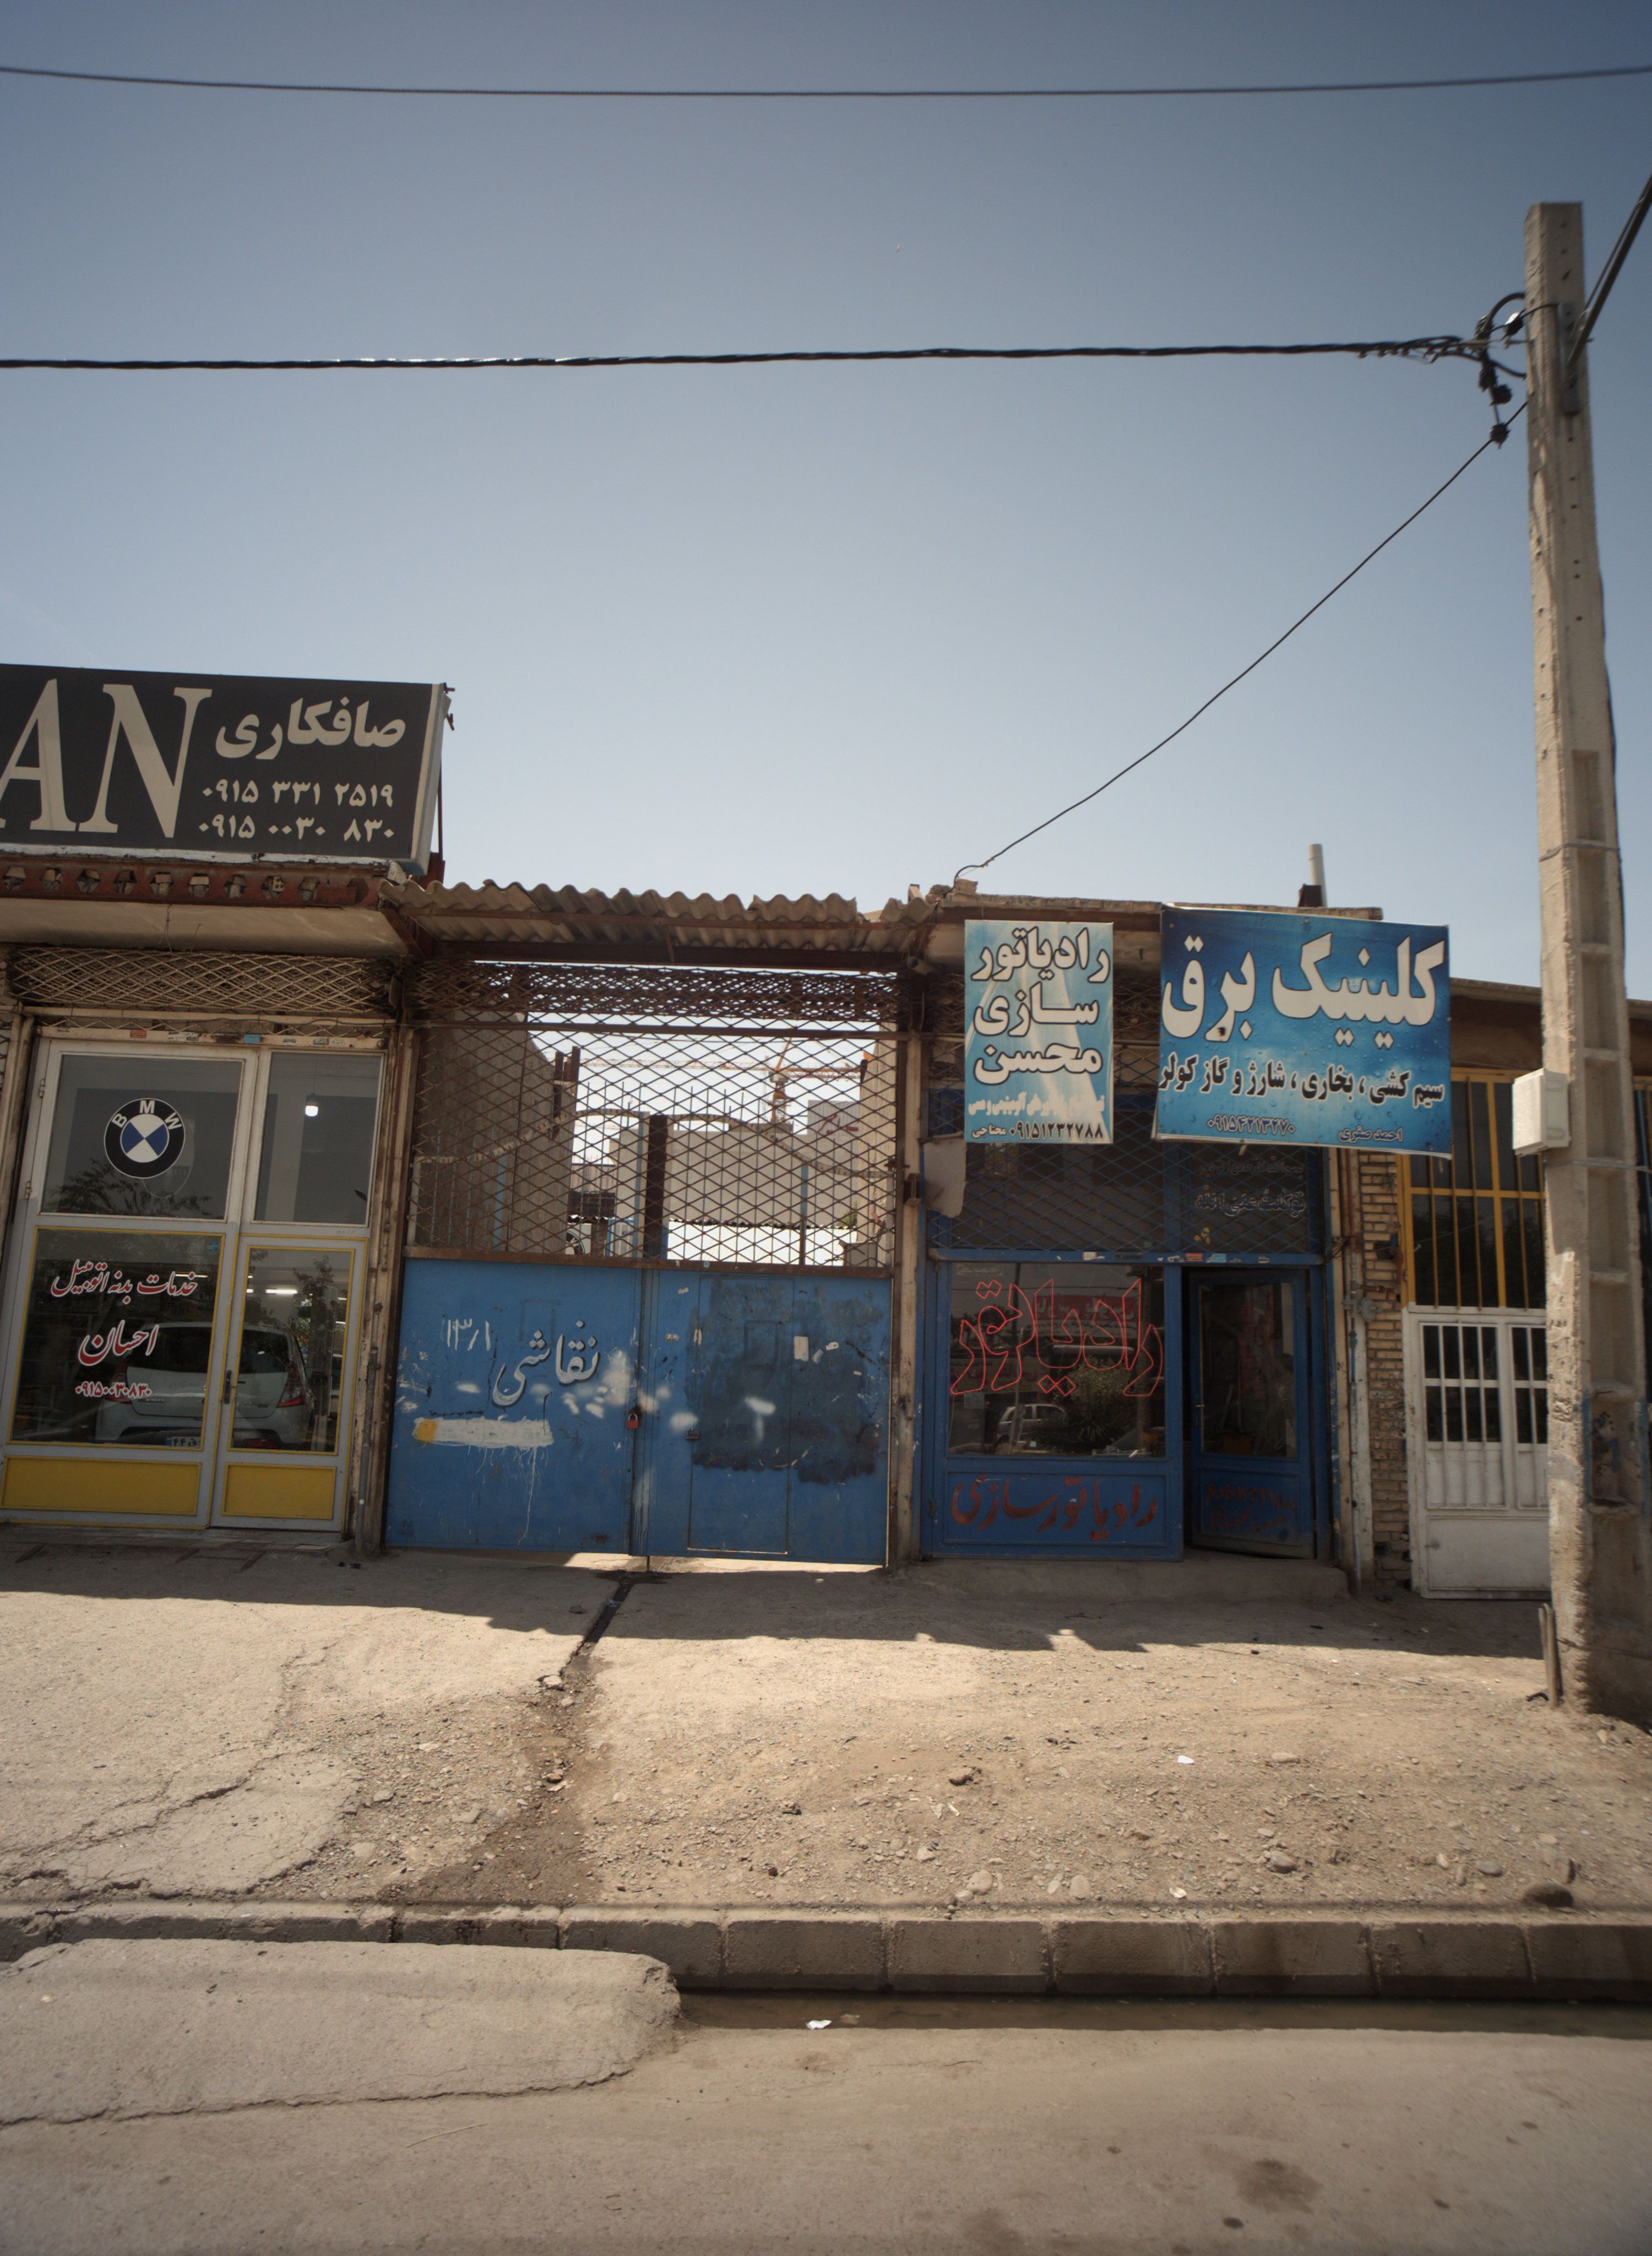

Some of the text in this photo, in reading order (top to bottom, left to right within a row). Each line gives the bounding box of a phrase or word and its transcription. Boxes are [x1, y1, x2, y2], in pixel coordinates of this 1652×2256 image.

[215, 696, 406, 760] صافکاری
[202, 779, 394, 809] ۰۹۱۵ ۳۳۱ ۲۵۱۹
[198, 814, 394, 843] ۰۹۱۵ ۰۰۳۰ ۸۳۰
[971, 926, 1110, 983] رادیاتور
[1161, 932, 1446, 1049] کلینیک برق
[973, 981, 1099, 1037] سازی
[974, 1043, 1103, 1086] محسن
[1159, 1052, 1198, 1091] کولر
[1200, 1056, 1229, 1093] گاز
[1246, 1060, 1285, 1096] شارژ
[1230, 1070, 1242, 1095] و
[1412, 1083, 1445, 1108] سیم
[112, 1100, 182, 1130] BMW
[971, 1124, 1006, 1138] محتاجی
[1339, 1127, 1371, 1143] صفری
[1373, 1127, 1403, 1142] احمد
[107, 1270, 133, 1304] بدنه
[137, 1271, 198, 1296] خدمات
[78, 1319, 159, 1366] احسان
[950, 1277, 1163, 1398] رادیاتور
[492, 1320, 601, 1407] نقاشی
[75, 1381, 152, 1398] ۰۹۱۵۰۰۳۰۸۳۰
